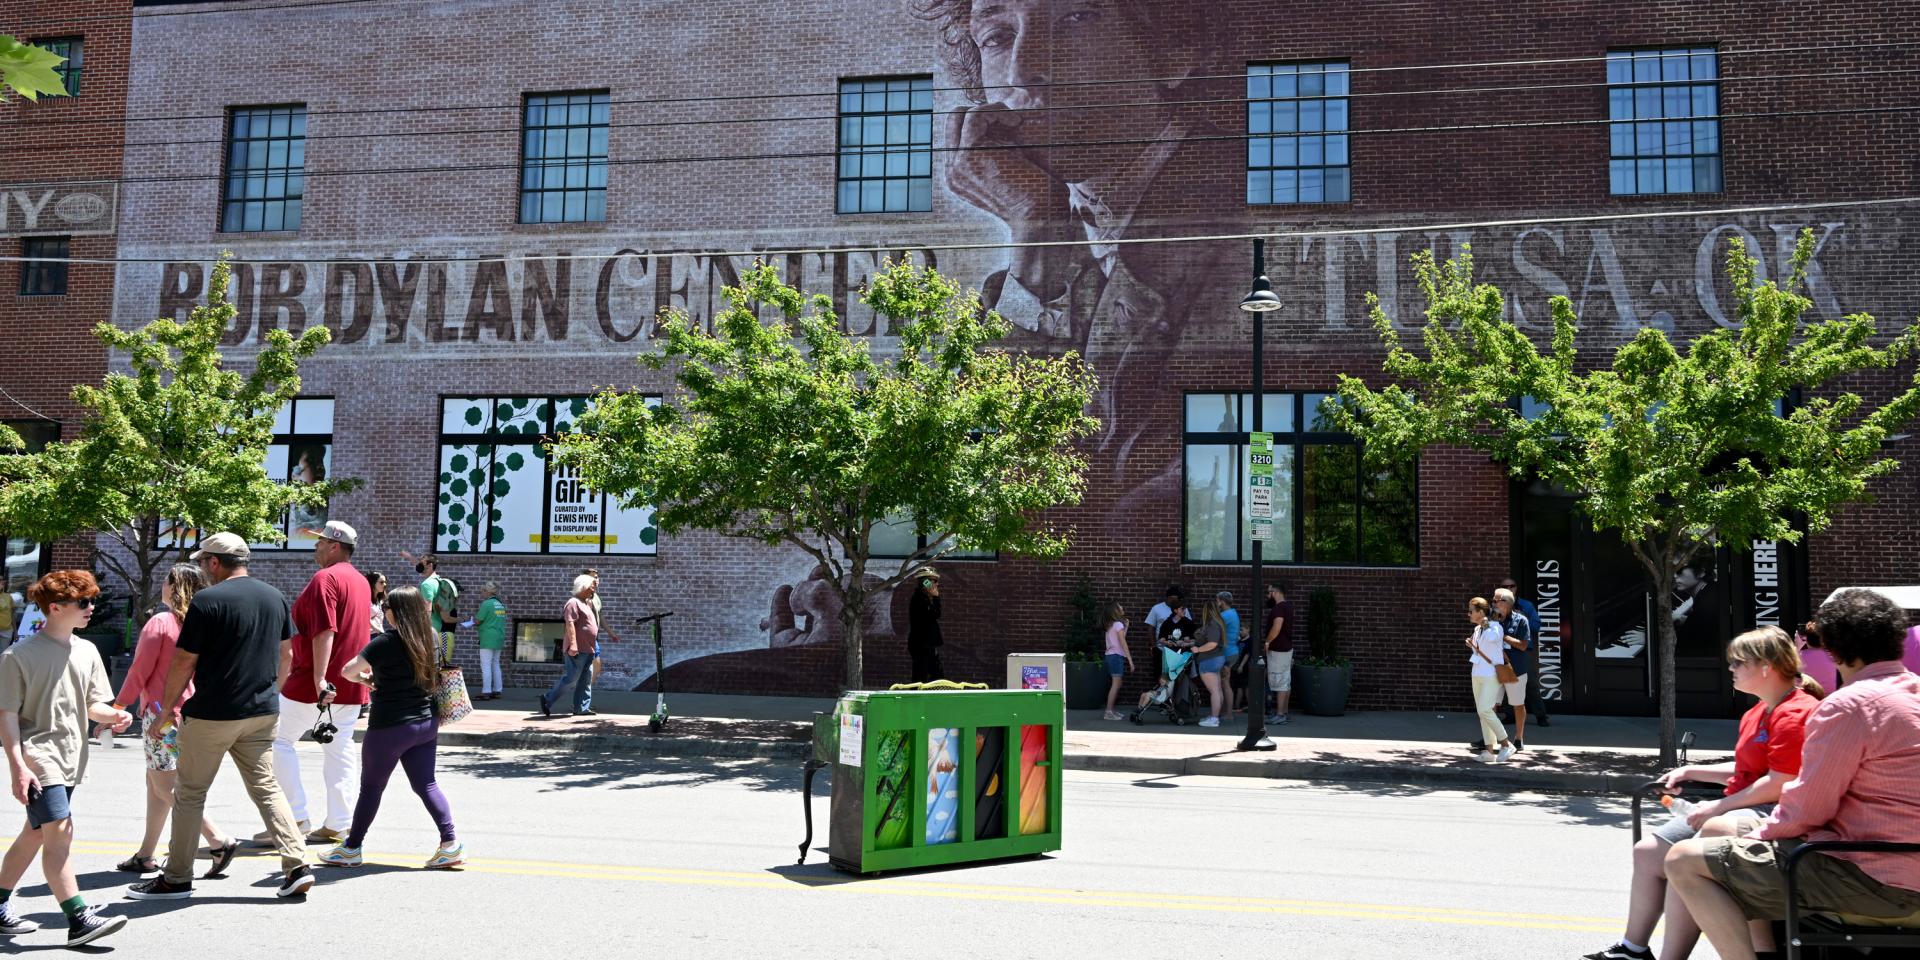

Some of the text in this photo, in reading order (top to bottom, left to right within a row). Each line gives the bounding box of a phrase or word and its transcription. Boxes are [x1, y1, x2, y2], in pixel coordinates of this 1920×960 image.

[0, 190, 56, 229] Y
[156, 258, 307, 346] BOB
[323, 253, 572, 345] DYLAN
[1252, 454, 1272, 464] 3210
[554, 505, 586, 513] CURATED BY
[554, 513, 598, 523] LEWIS HYDE
[1753, 539, 1778, 587] HERE
[1537, 559, 1562, 701] SOMETHING IS
